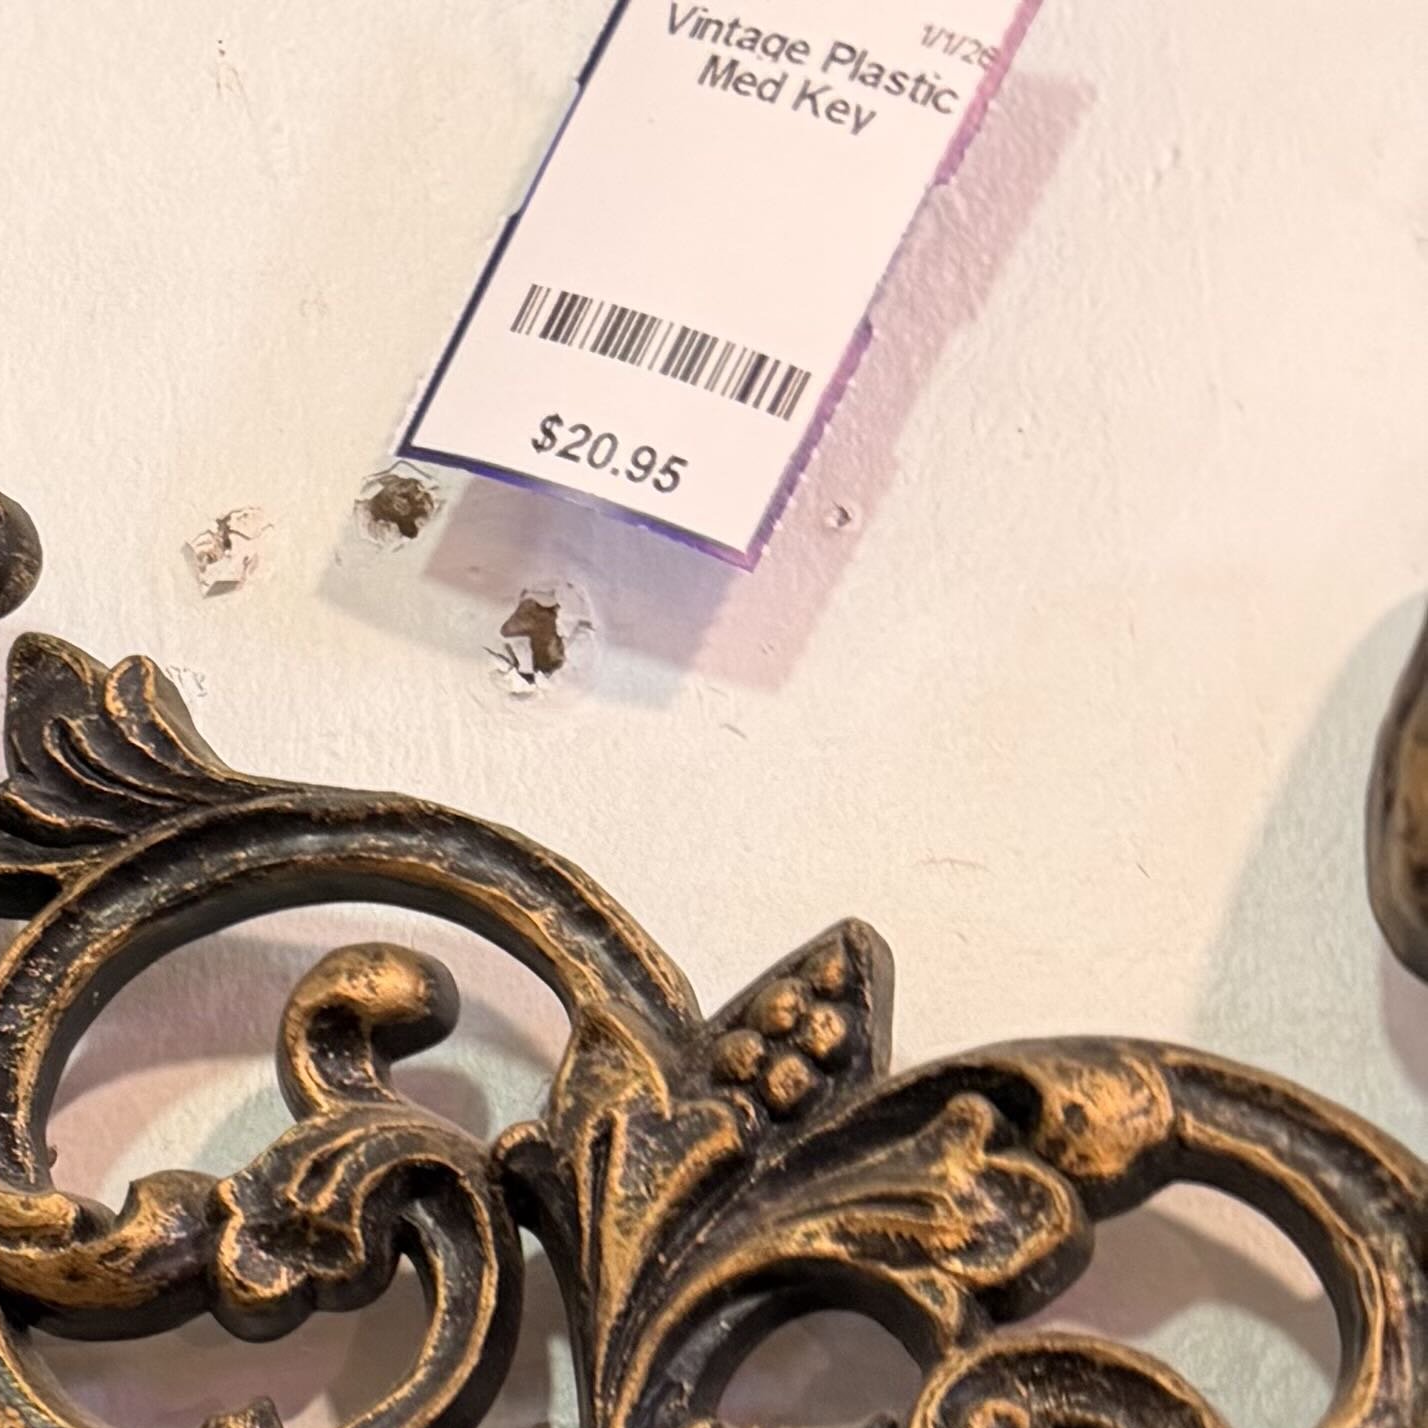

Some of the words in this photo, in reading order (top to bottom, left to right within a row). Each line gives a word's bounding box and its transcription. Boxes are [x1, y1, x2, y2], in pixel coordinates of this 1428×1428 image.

[667, 1, 811, 66] Vintage
[820, 40, 960, 114] Plastic
[697, 54, 789, 104] Med
[791, 78, 878, 136] Key
[531, 413, 689, 493] $20.95
